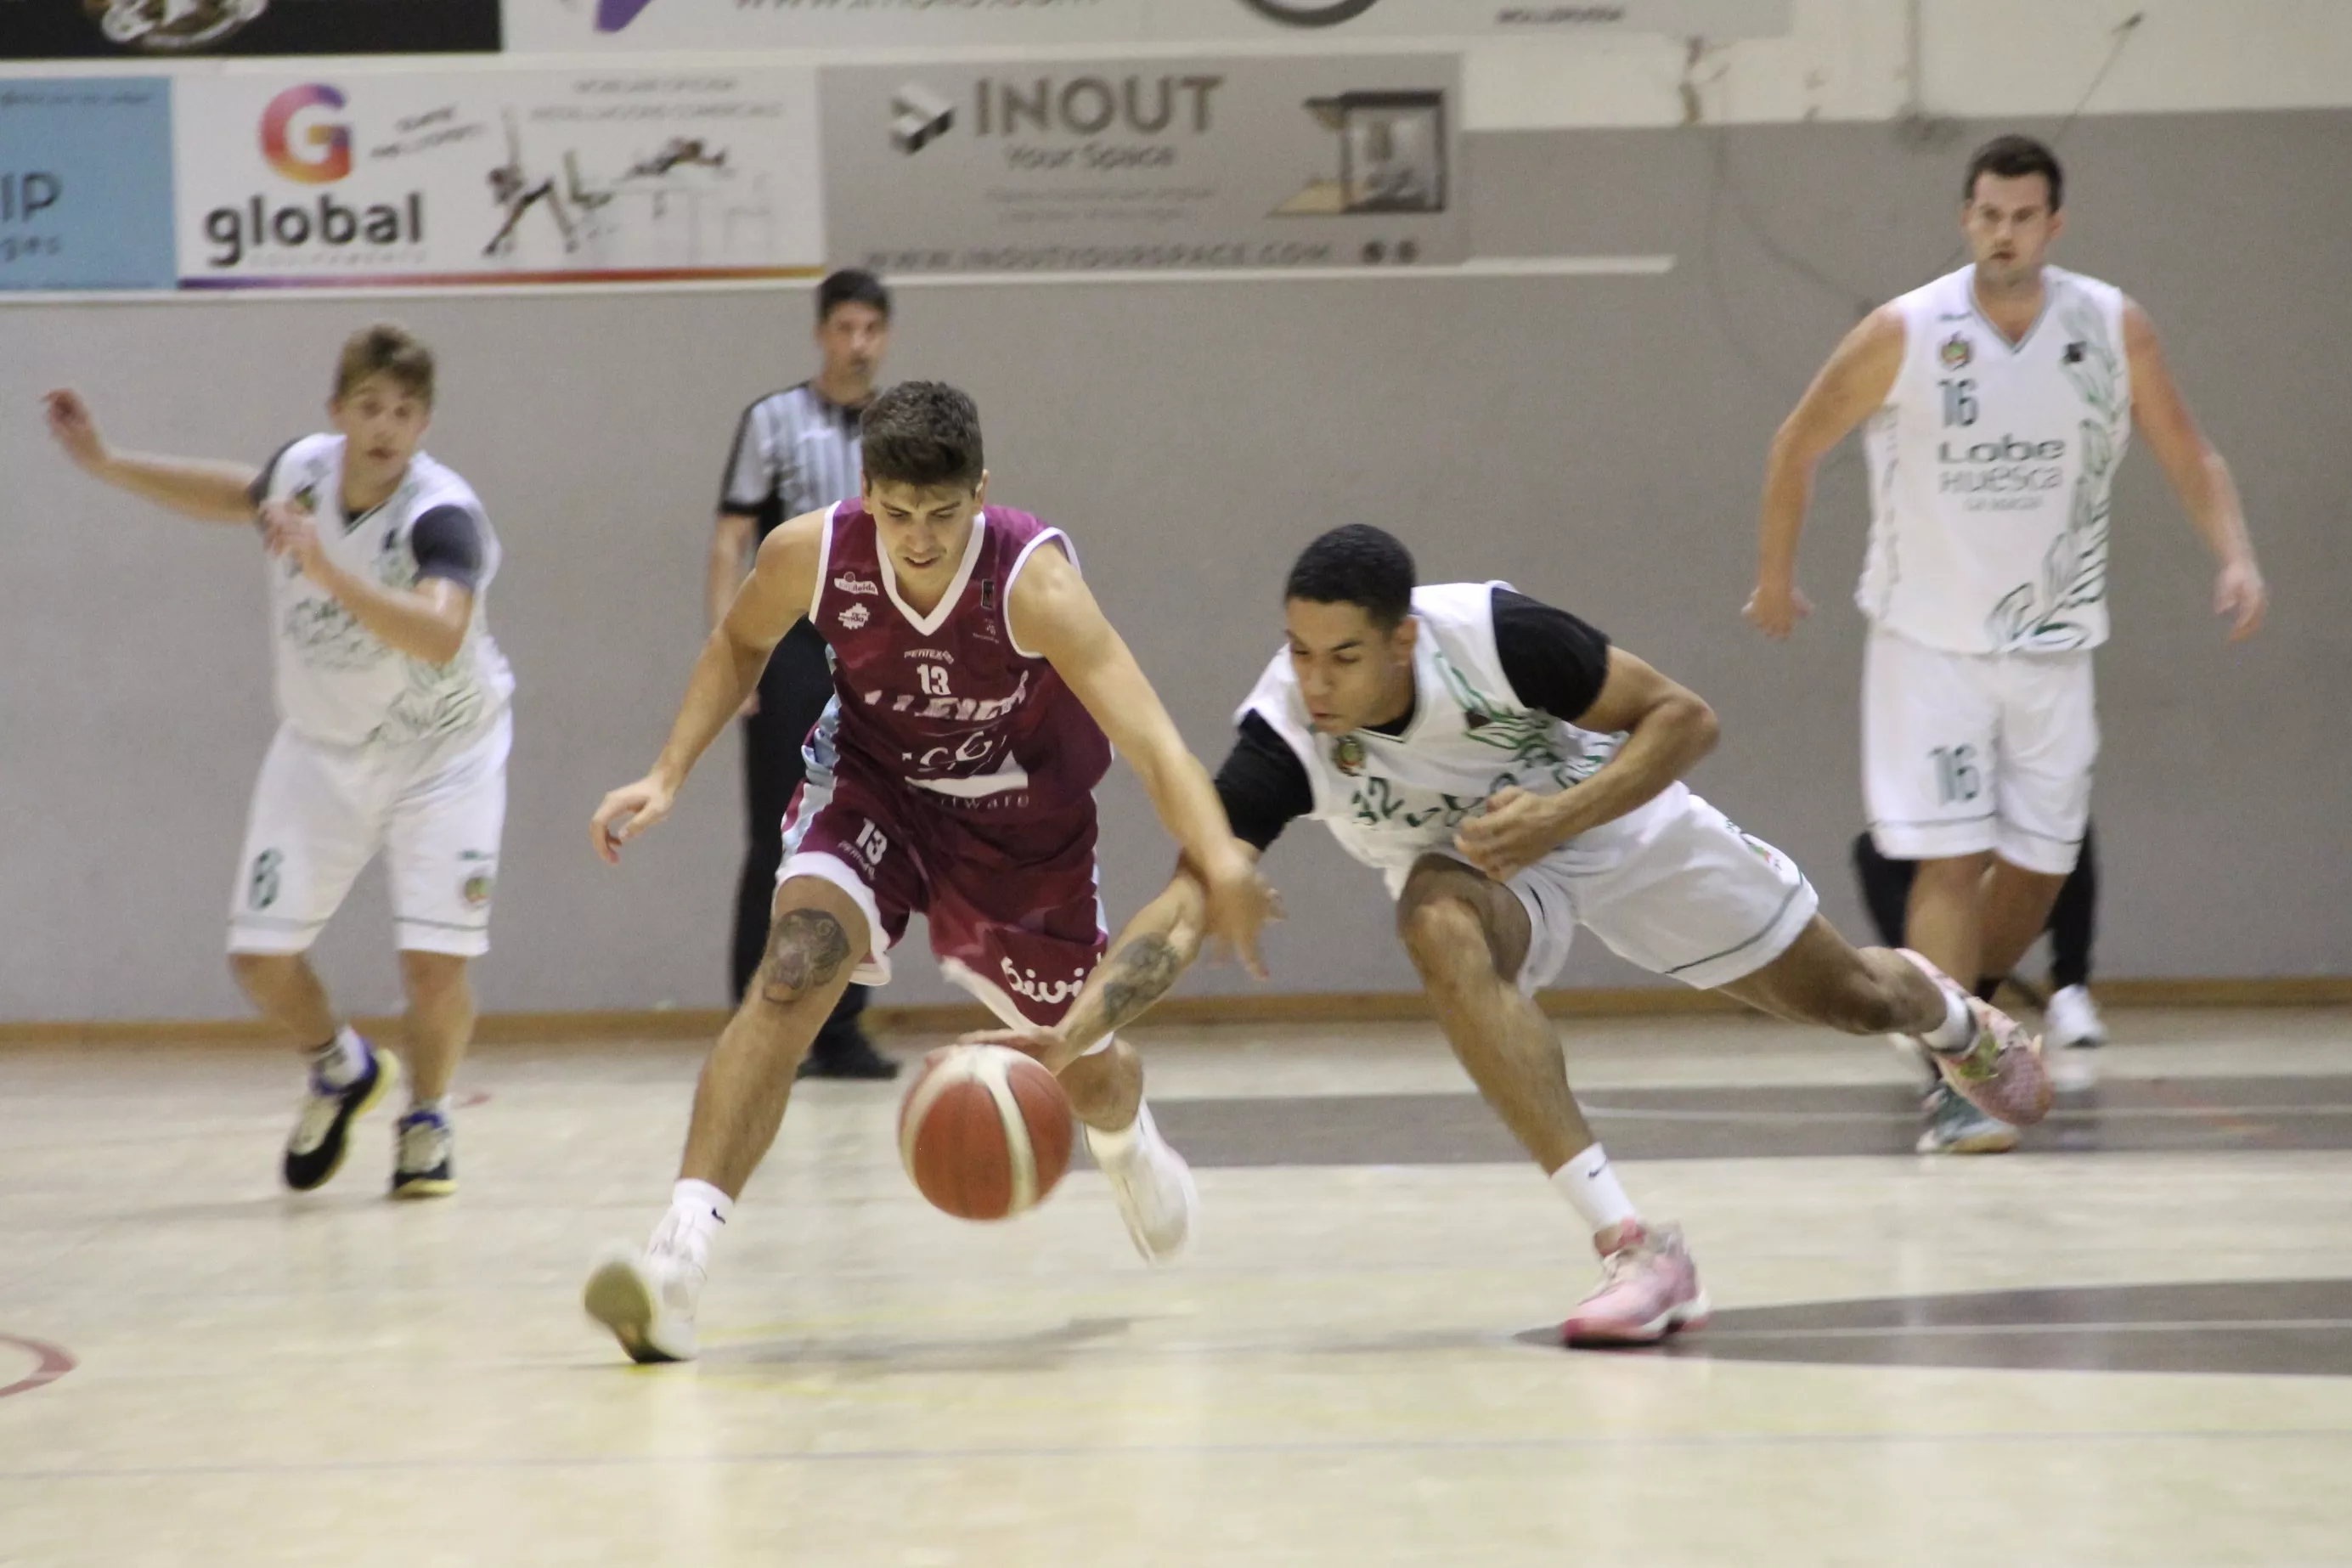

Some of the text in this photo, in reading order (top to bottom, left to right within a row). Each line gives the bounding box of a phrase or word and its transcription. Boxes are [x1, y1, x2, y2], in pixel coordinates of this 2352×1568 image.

[974, 75, 1225, 138] INOUT
[1082, 140, 1177, 172] Space
[204, 192, 423, 268] global
[1936, 379, 1978, 427] 16
[1938, 434, 2065, 464] Lobe
[917, 663, 952, 696] 13
[1926, 743, 1982, 805] 16
[855, 817, 888, 866] 13
